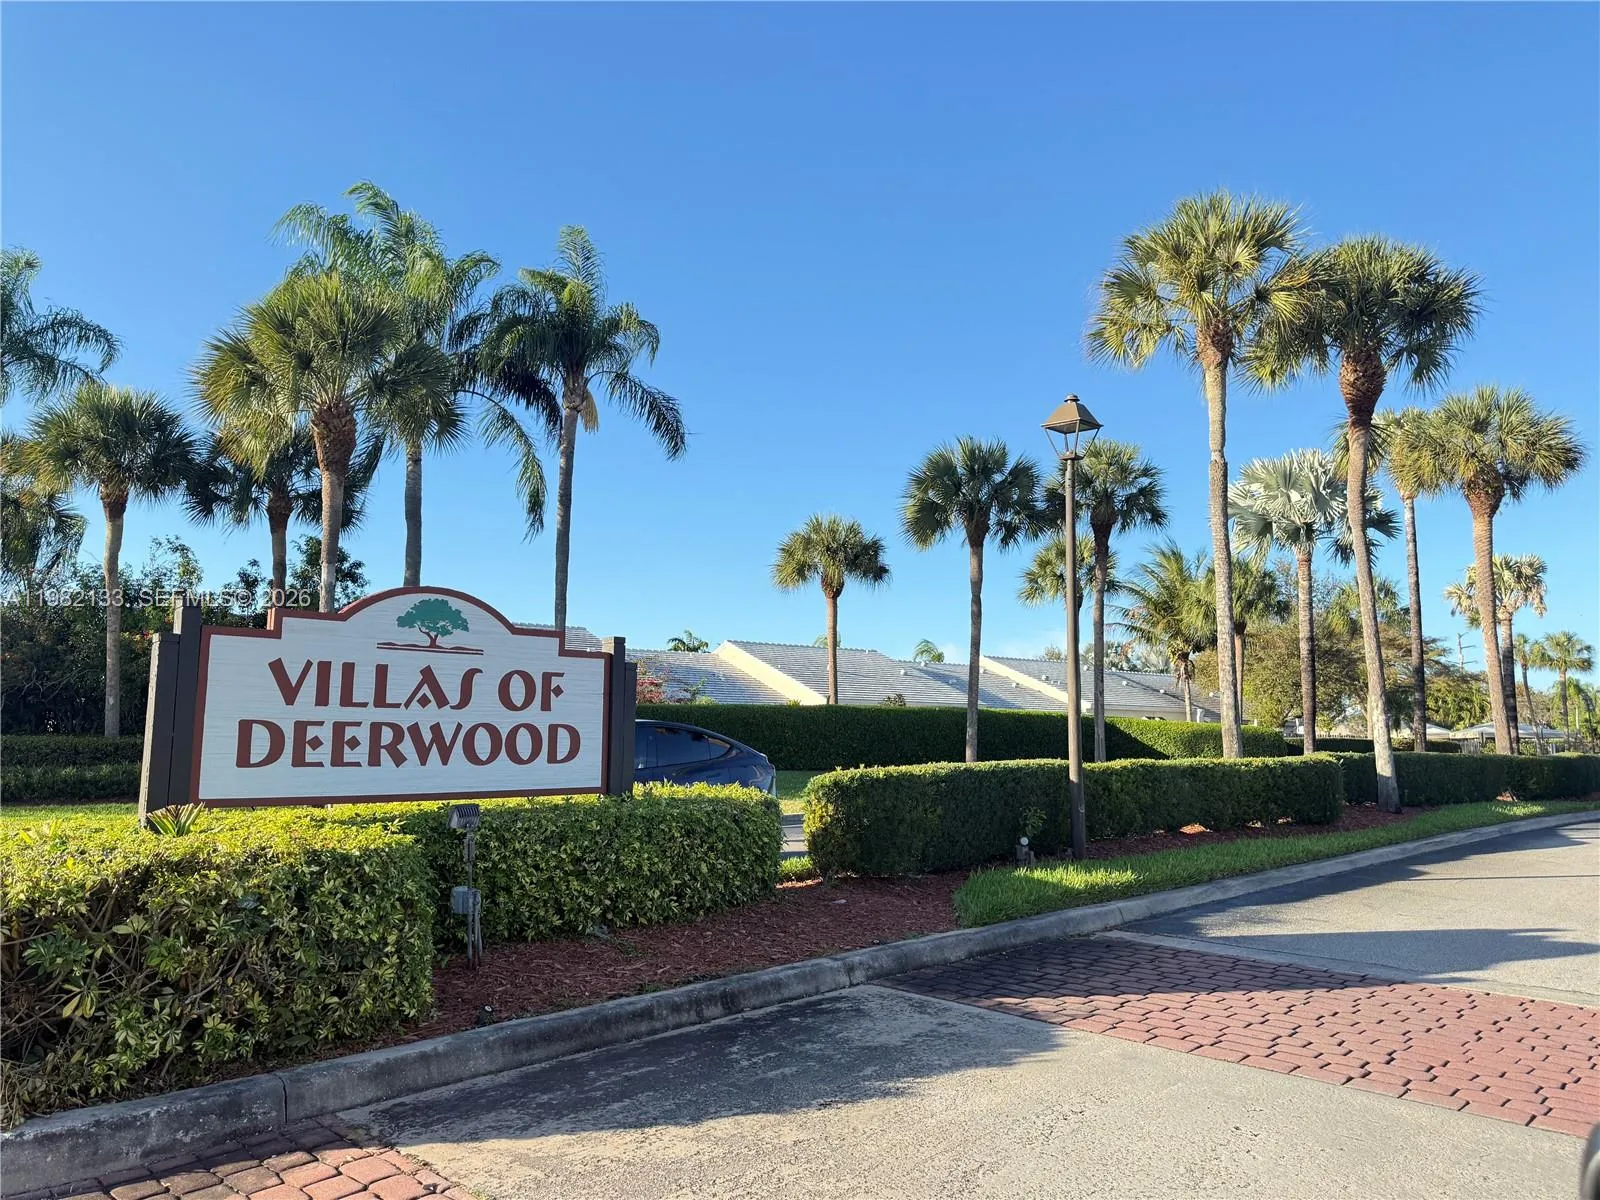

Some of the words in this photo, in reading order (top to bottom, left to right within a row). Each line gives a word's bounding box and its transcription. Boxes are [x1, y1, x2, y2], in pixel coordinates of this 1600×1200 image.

[267, 657, 483, 711] VILLAS
[497, 669, 565, 712] OF
[235, 719, 581, 769] DEERWOOD
